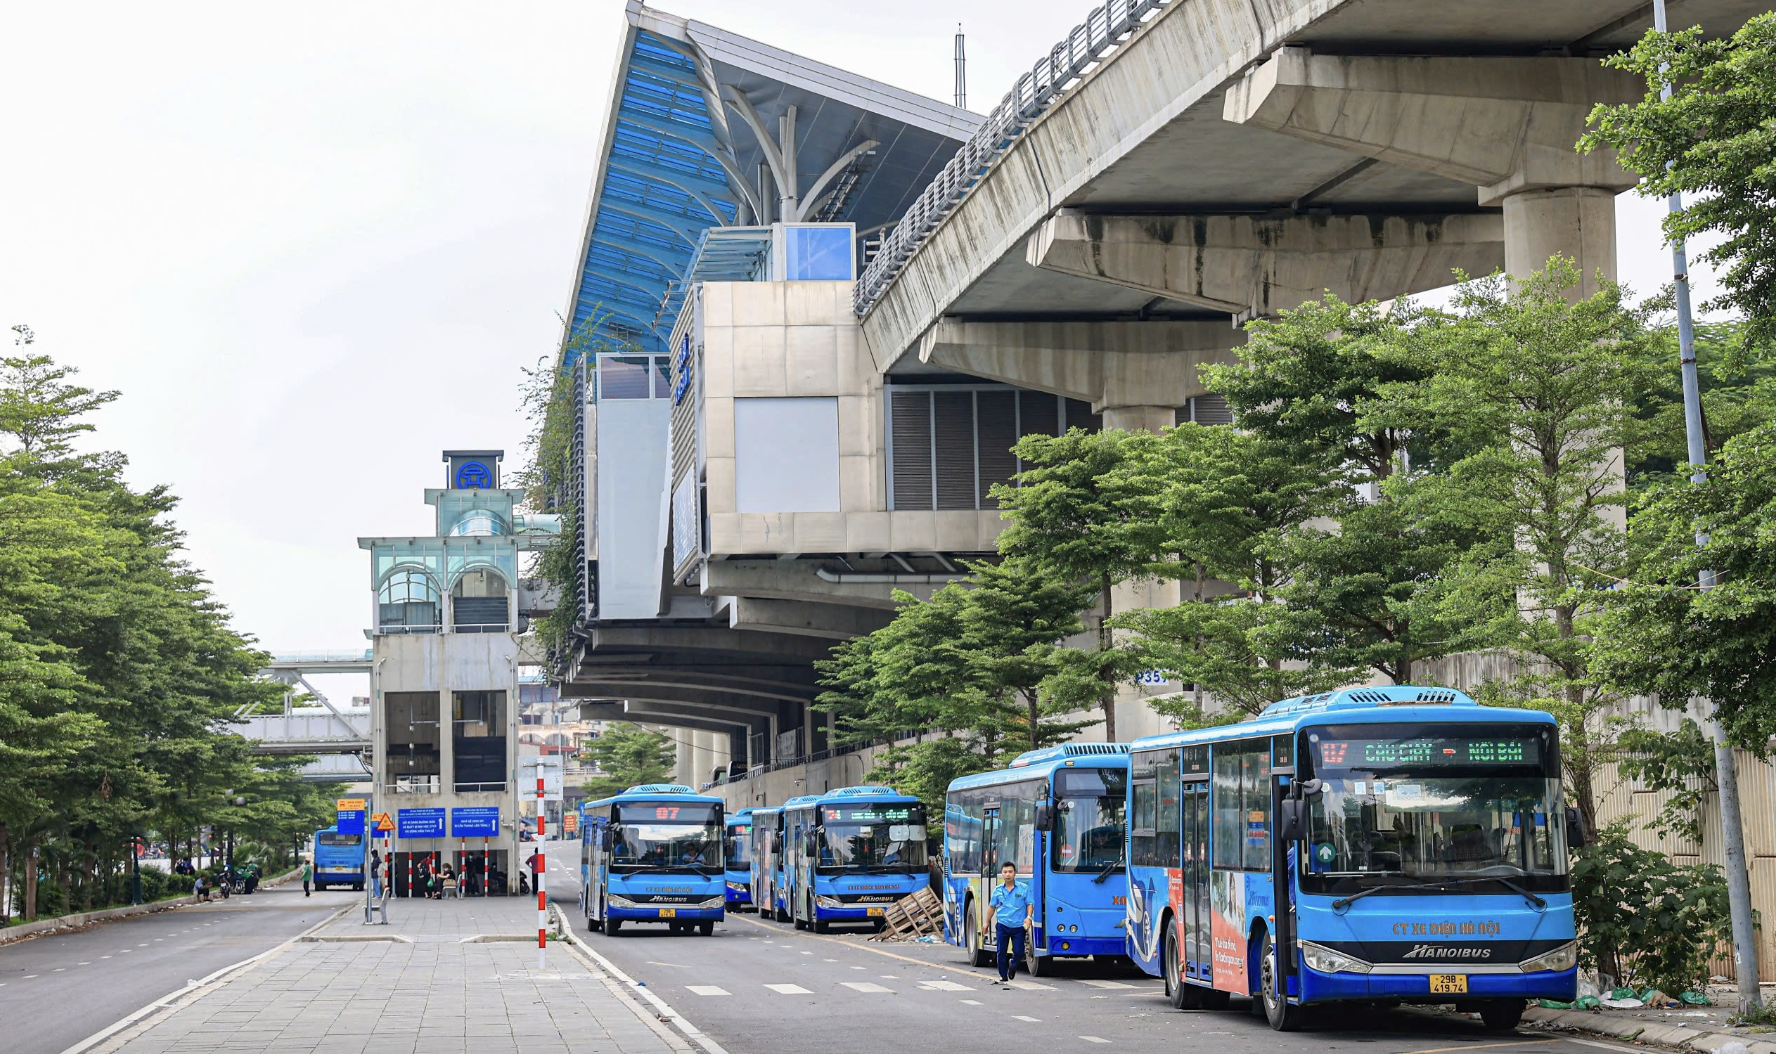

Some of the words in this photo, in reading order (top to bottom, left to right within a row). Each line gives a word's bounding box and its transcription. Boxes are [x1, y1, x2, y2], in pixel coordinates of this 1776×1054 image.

[655, 806, 680, 820] 07
[1392, 923, 1409, 935] CT
[1412, 923, 1427, 935] XE
[1429, 921, 1457, 938] ĐIỆN
[1460, 920, 1475, 935] HÀ
[1478, 920, 1500, 938] NỘI
[1402, 944, 1491, 958] HANOIBUS
[1440, 975, 1456, 983] 29B
[1434, 984, 1463, 993] 419.74
